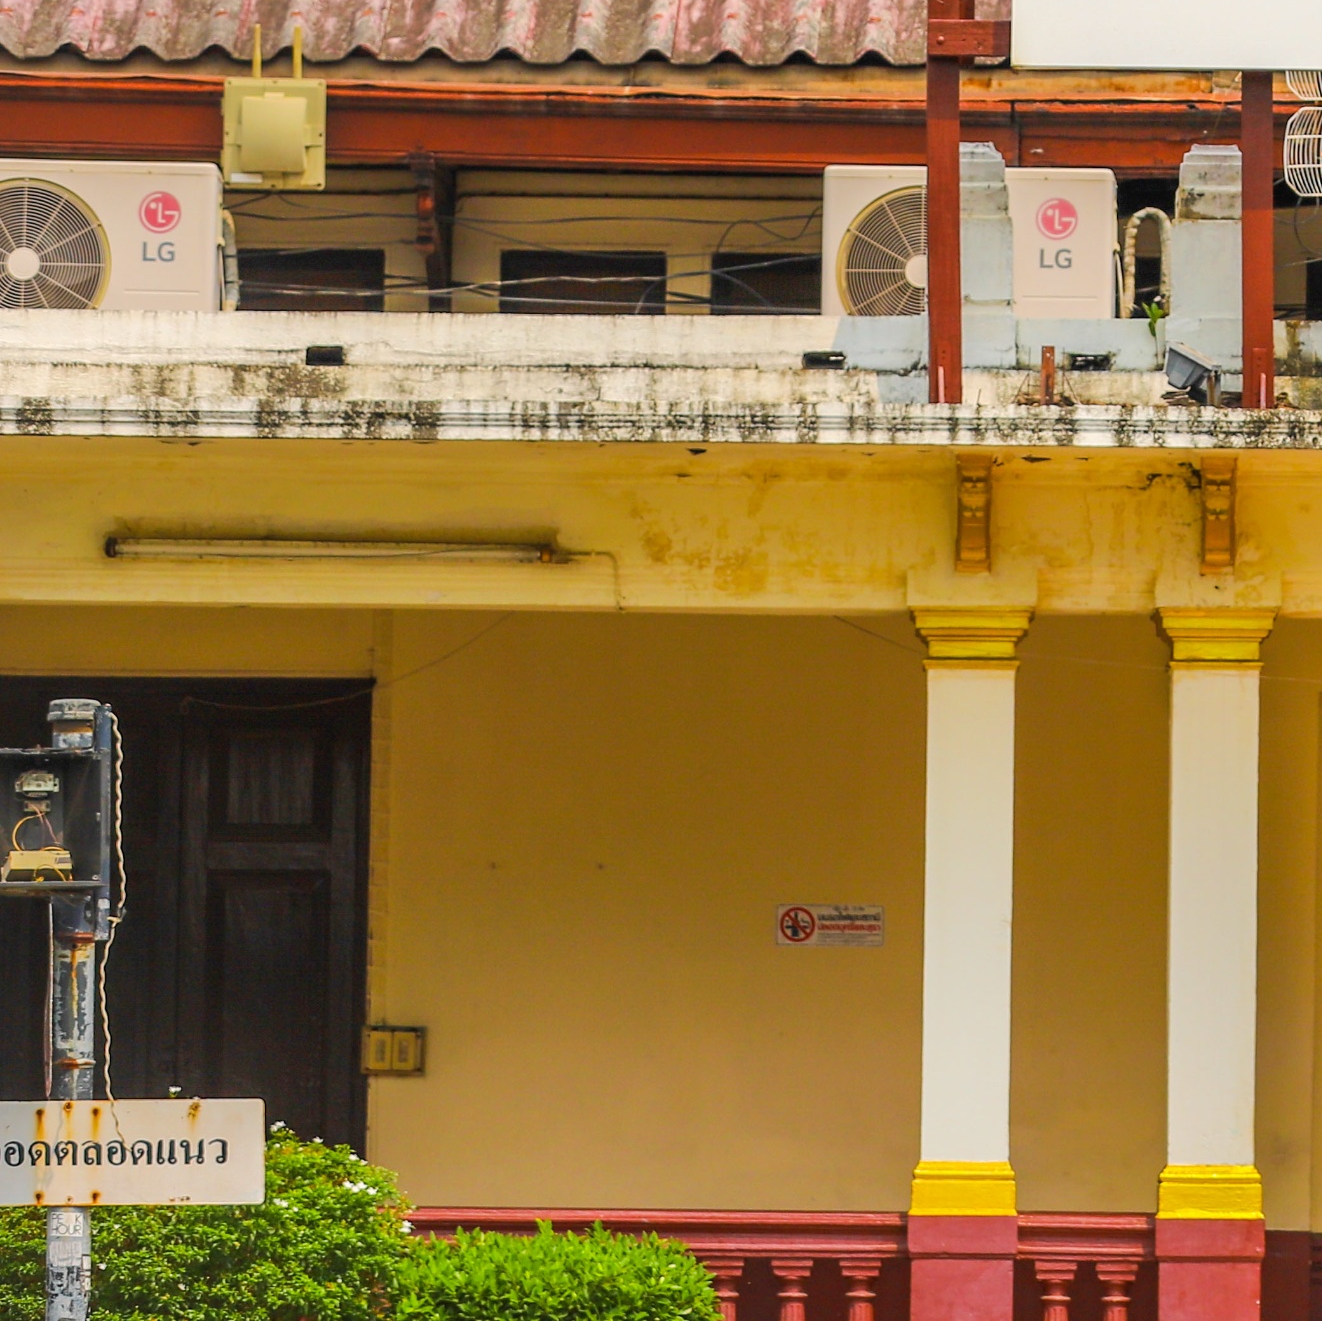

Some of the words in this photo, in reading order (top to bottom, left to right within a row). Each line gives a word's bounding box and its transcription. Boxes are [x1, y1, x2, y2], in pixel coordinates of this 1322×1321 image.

[141, 240, 176, 263] LG
[1038, 247, 1073, 270] LG
[0, 1138, 228, 1167] อดตลอดแนว
[51, 1213, 82, 1225] PEK
